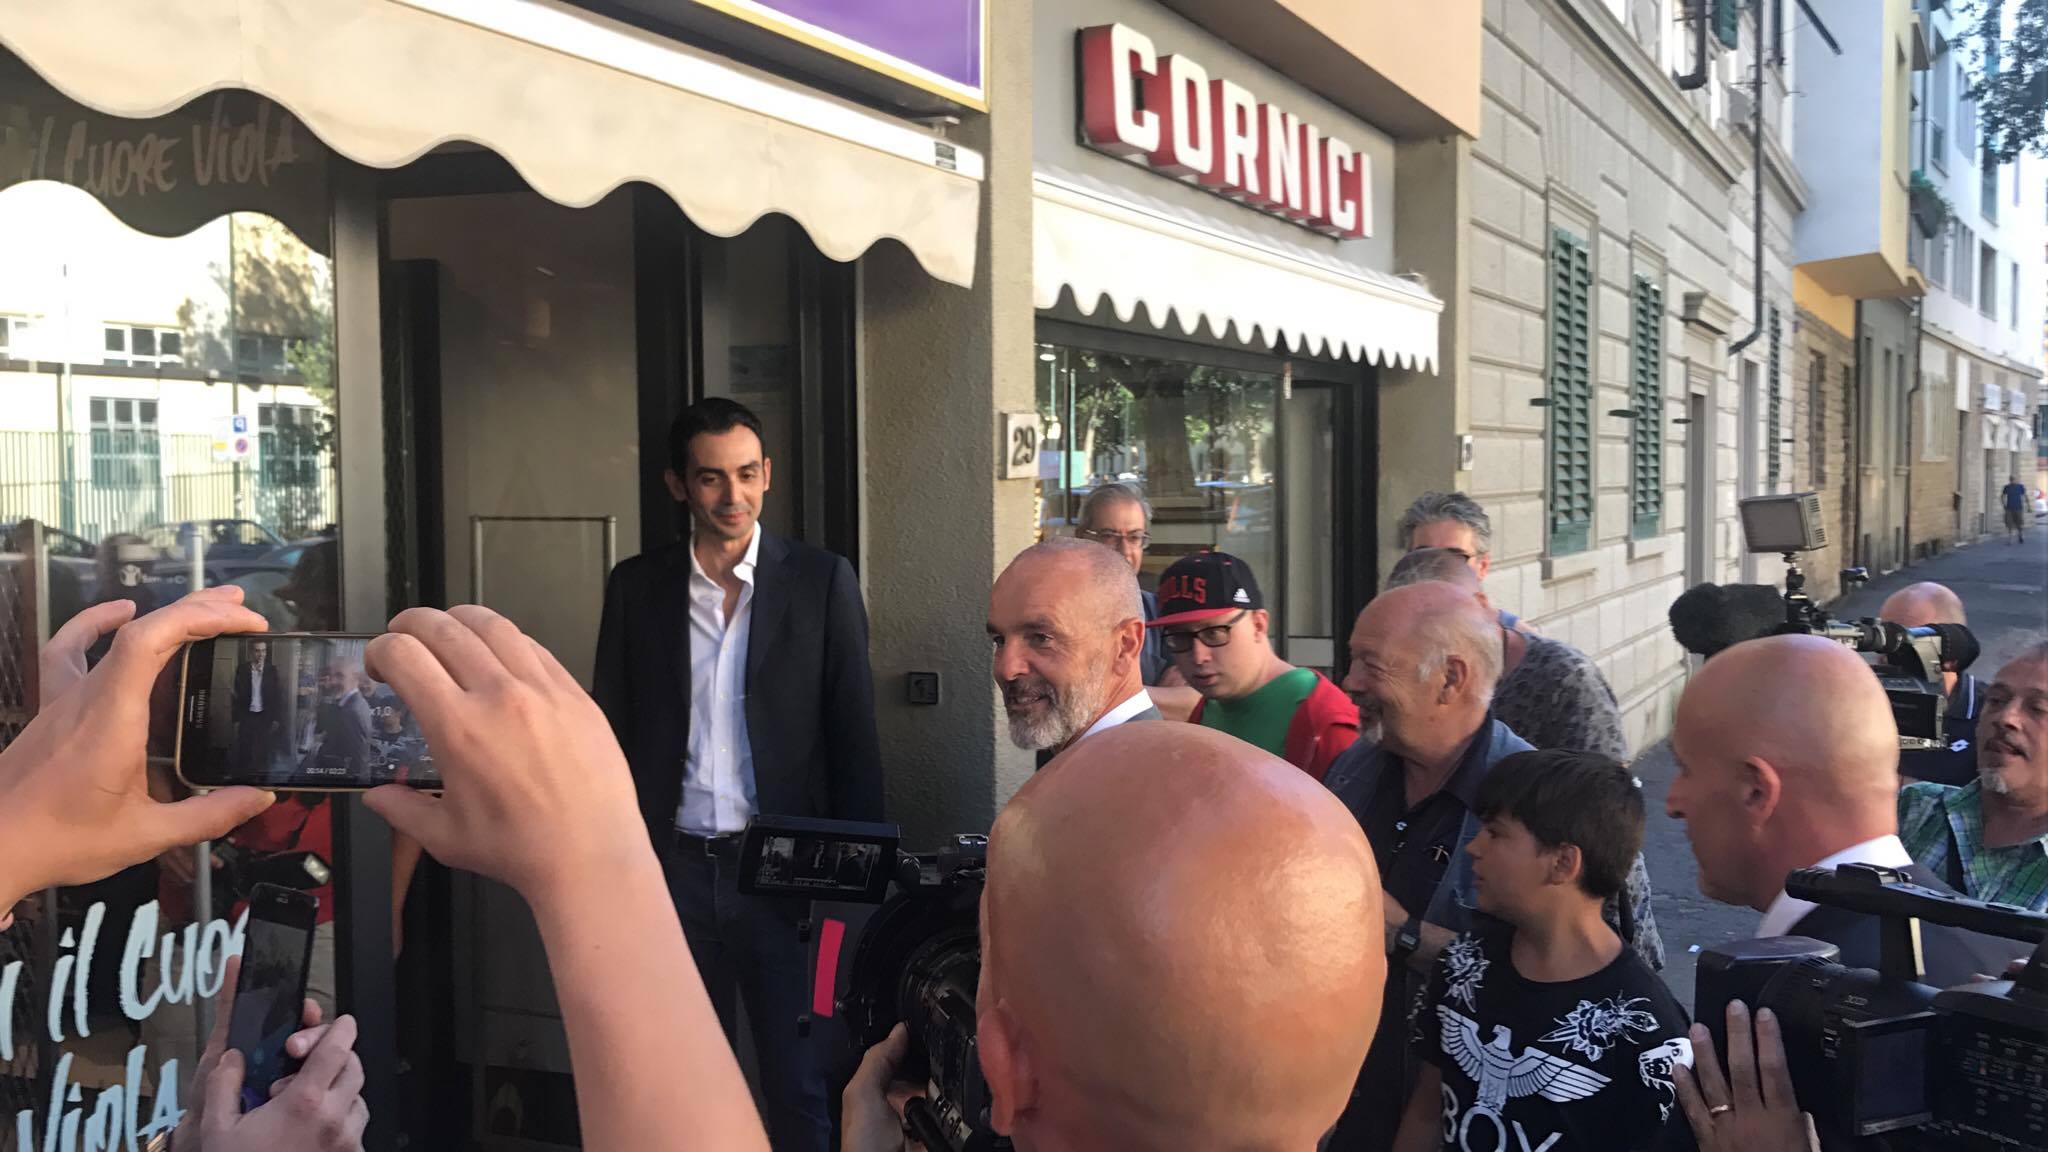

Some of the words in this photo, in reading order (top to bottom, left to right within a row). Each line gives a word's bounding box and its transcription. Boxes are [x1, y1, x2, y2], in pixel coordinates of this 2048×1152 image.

[1111, 22, 1373, 238] CORNICI
[1012, 426, 1036, 466] 29
[48, 901, 106, 1043] il
[119, 899, 250, 1020] Cuo
